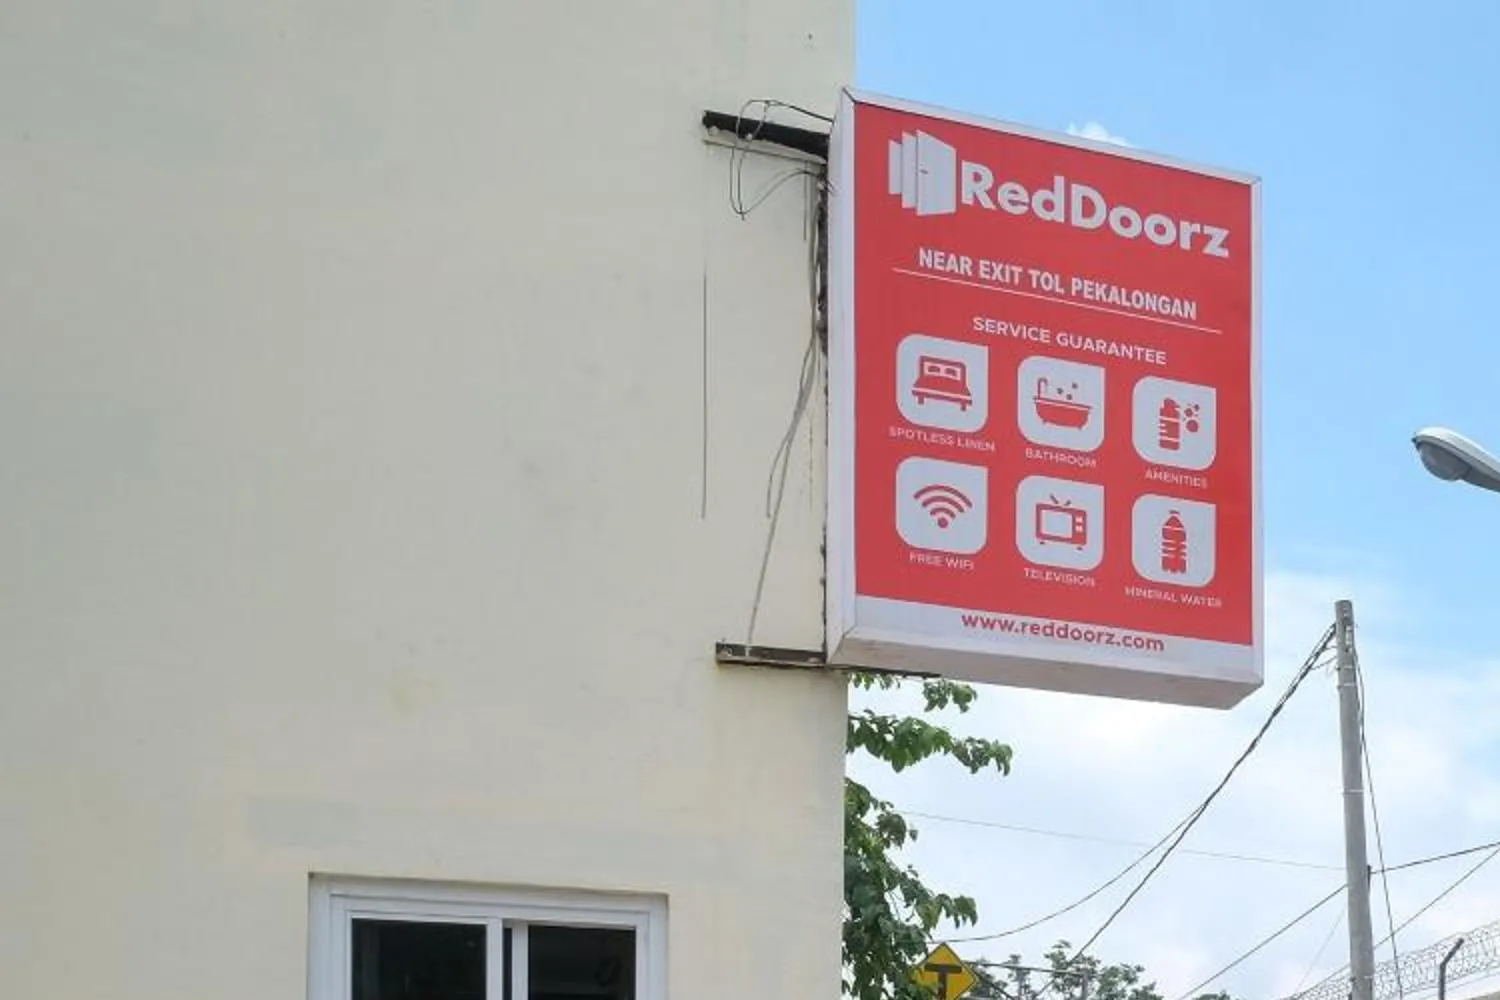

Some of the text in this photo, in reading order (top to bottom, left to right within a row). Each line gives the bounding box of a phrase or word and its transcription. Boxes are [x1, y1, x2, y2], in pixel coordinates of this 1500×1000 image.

[961, 160, 1230, 258] RedDoorz
[918, 247, 1198, 321] NEAR EXIT TOL PEKALONGAN
[972, 316, 1168, 366] SERVICE GUARANTEE
[889, 426, 996, 453] SPOTLESS LINEN
[1024, 447, 1098, 469] BATHROOM
[1144, 467, 1209, 490] AMENITIES
[909, 551, 975, 571] FREE WIFI
[1023, 567, 1097, 588] TELEVISION
[1124, 585, 1222, 608] MINERAL WATER
[961, 612, 1165, 652] www.reddoorz.com
